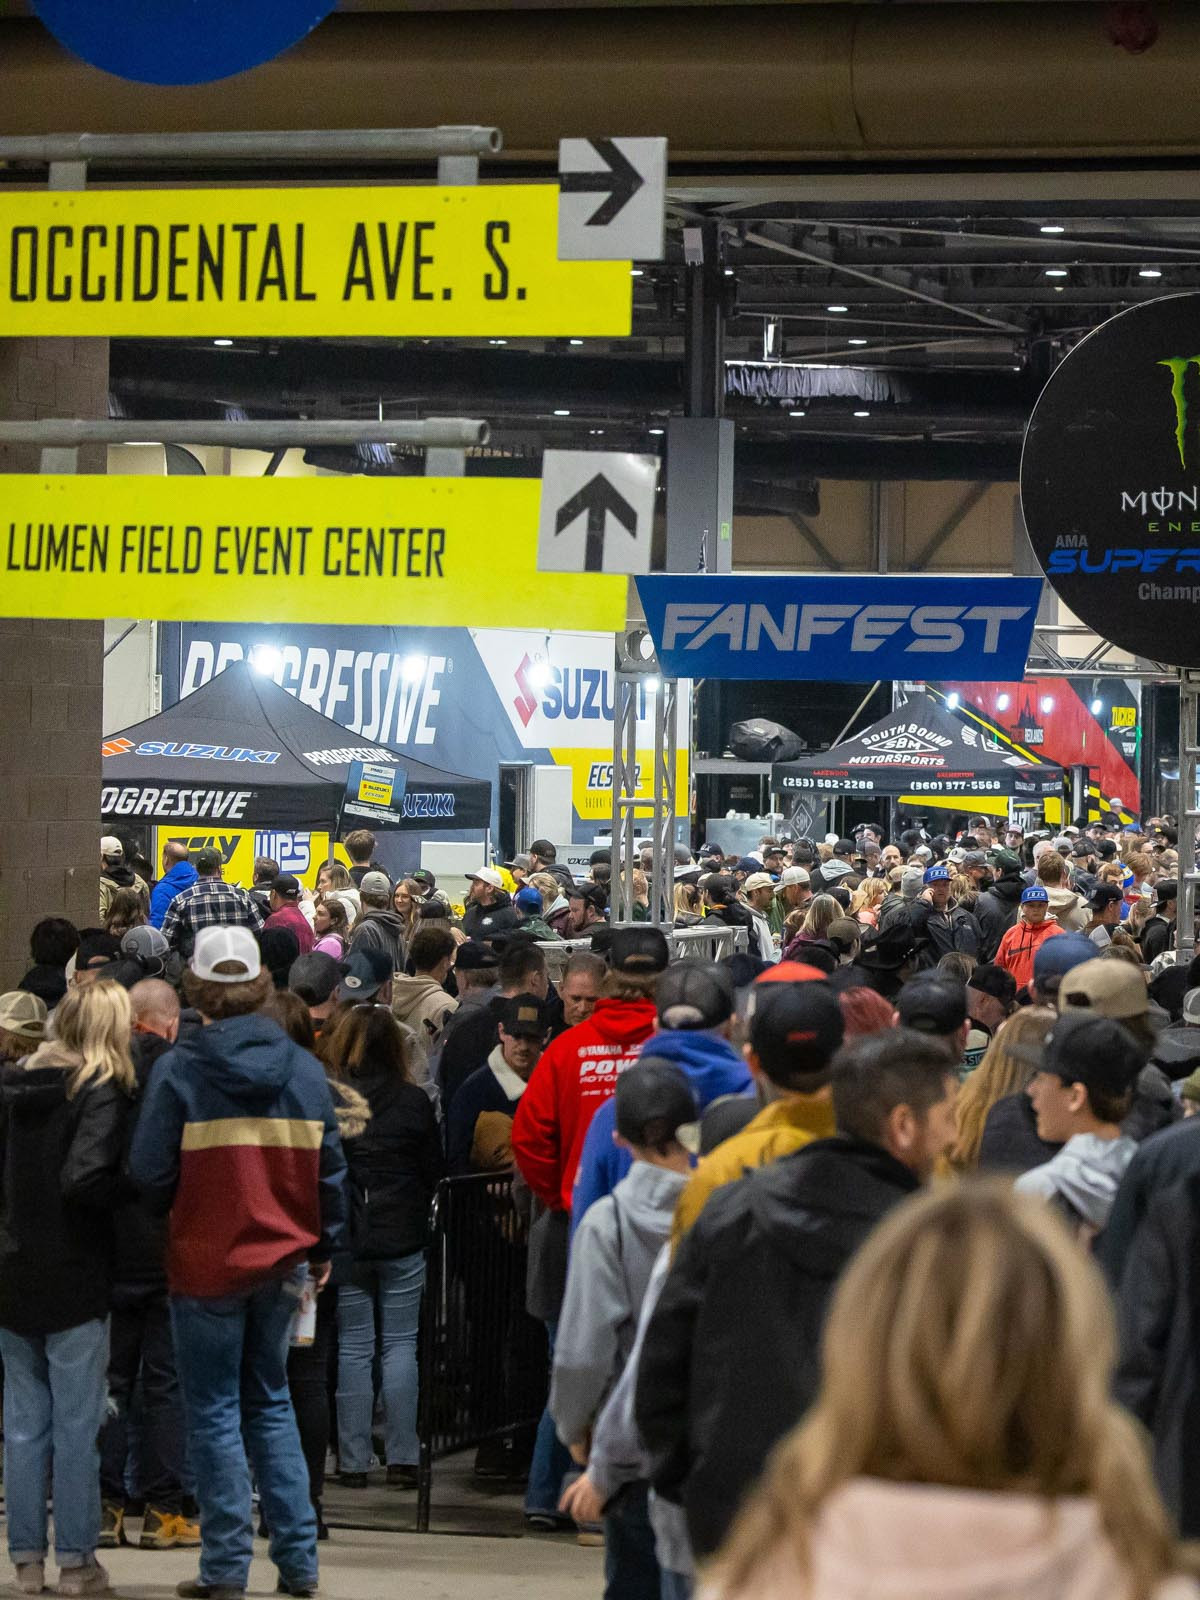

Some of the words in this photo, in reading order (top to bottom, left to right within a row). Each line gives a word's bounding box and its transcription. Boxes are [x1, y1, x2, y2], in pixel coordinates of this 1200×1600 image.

[10, 222, 317, 302] OCCIDENTAL
[343, 221, 453, 300] AVE.
[483, 220, 527, 300] S.
[1055, 534, 1089, 548] AMA
[6, 522, 108, 573] LUMEN
[120, 524, 203, 575] FIELD
[213, 525, 313, 576] EVENT
[322, 526, 446, 577] CENTER
[661, 603, 1031, 653] FANFEST
[542, 666, 646, 721] SUZUI
[861, 724, 906, 746] SOUTH
[907, 723, 953, 748] BOUND
[883, 737, 921, 750] SBM
[135, 741, 282, 764] SUZUKI
[302, 747, 400, 766] PROGRESSIVE
[848, 754, 945, 766] MOTORSPORTS
[782, 777, 814, 788] (253)
[910, 780, 943, 791] (360)
[945, 780, 1001, 790] 377-5568
[586, 1044, 622, 1056] YAMAHA
[580, 1074, 618, 1084] MOTO
